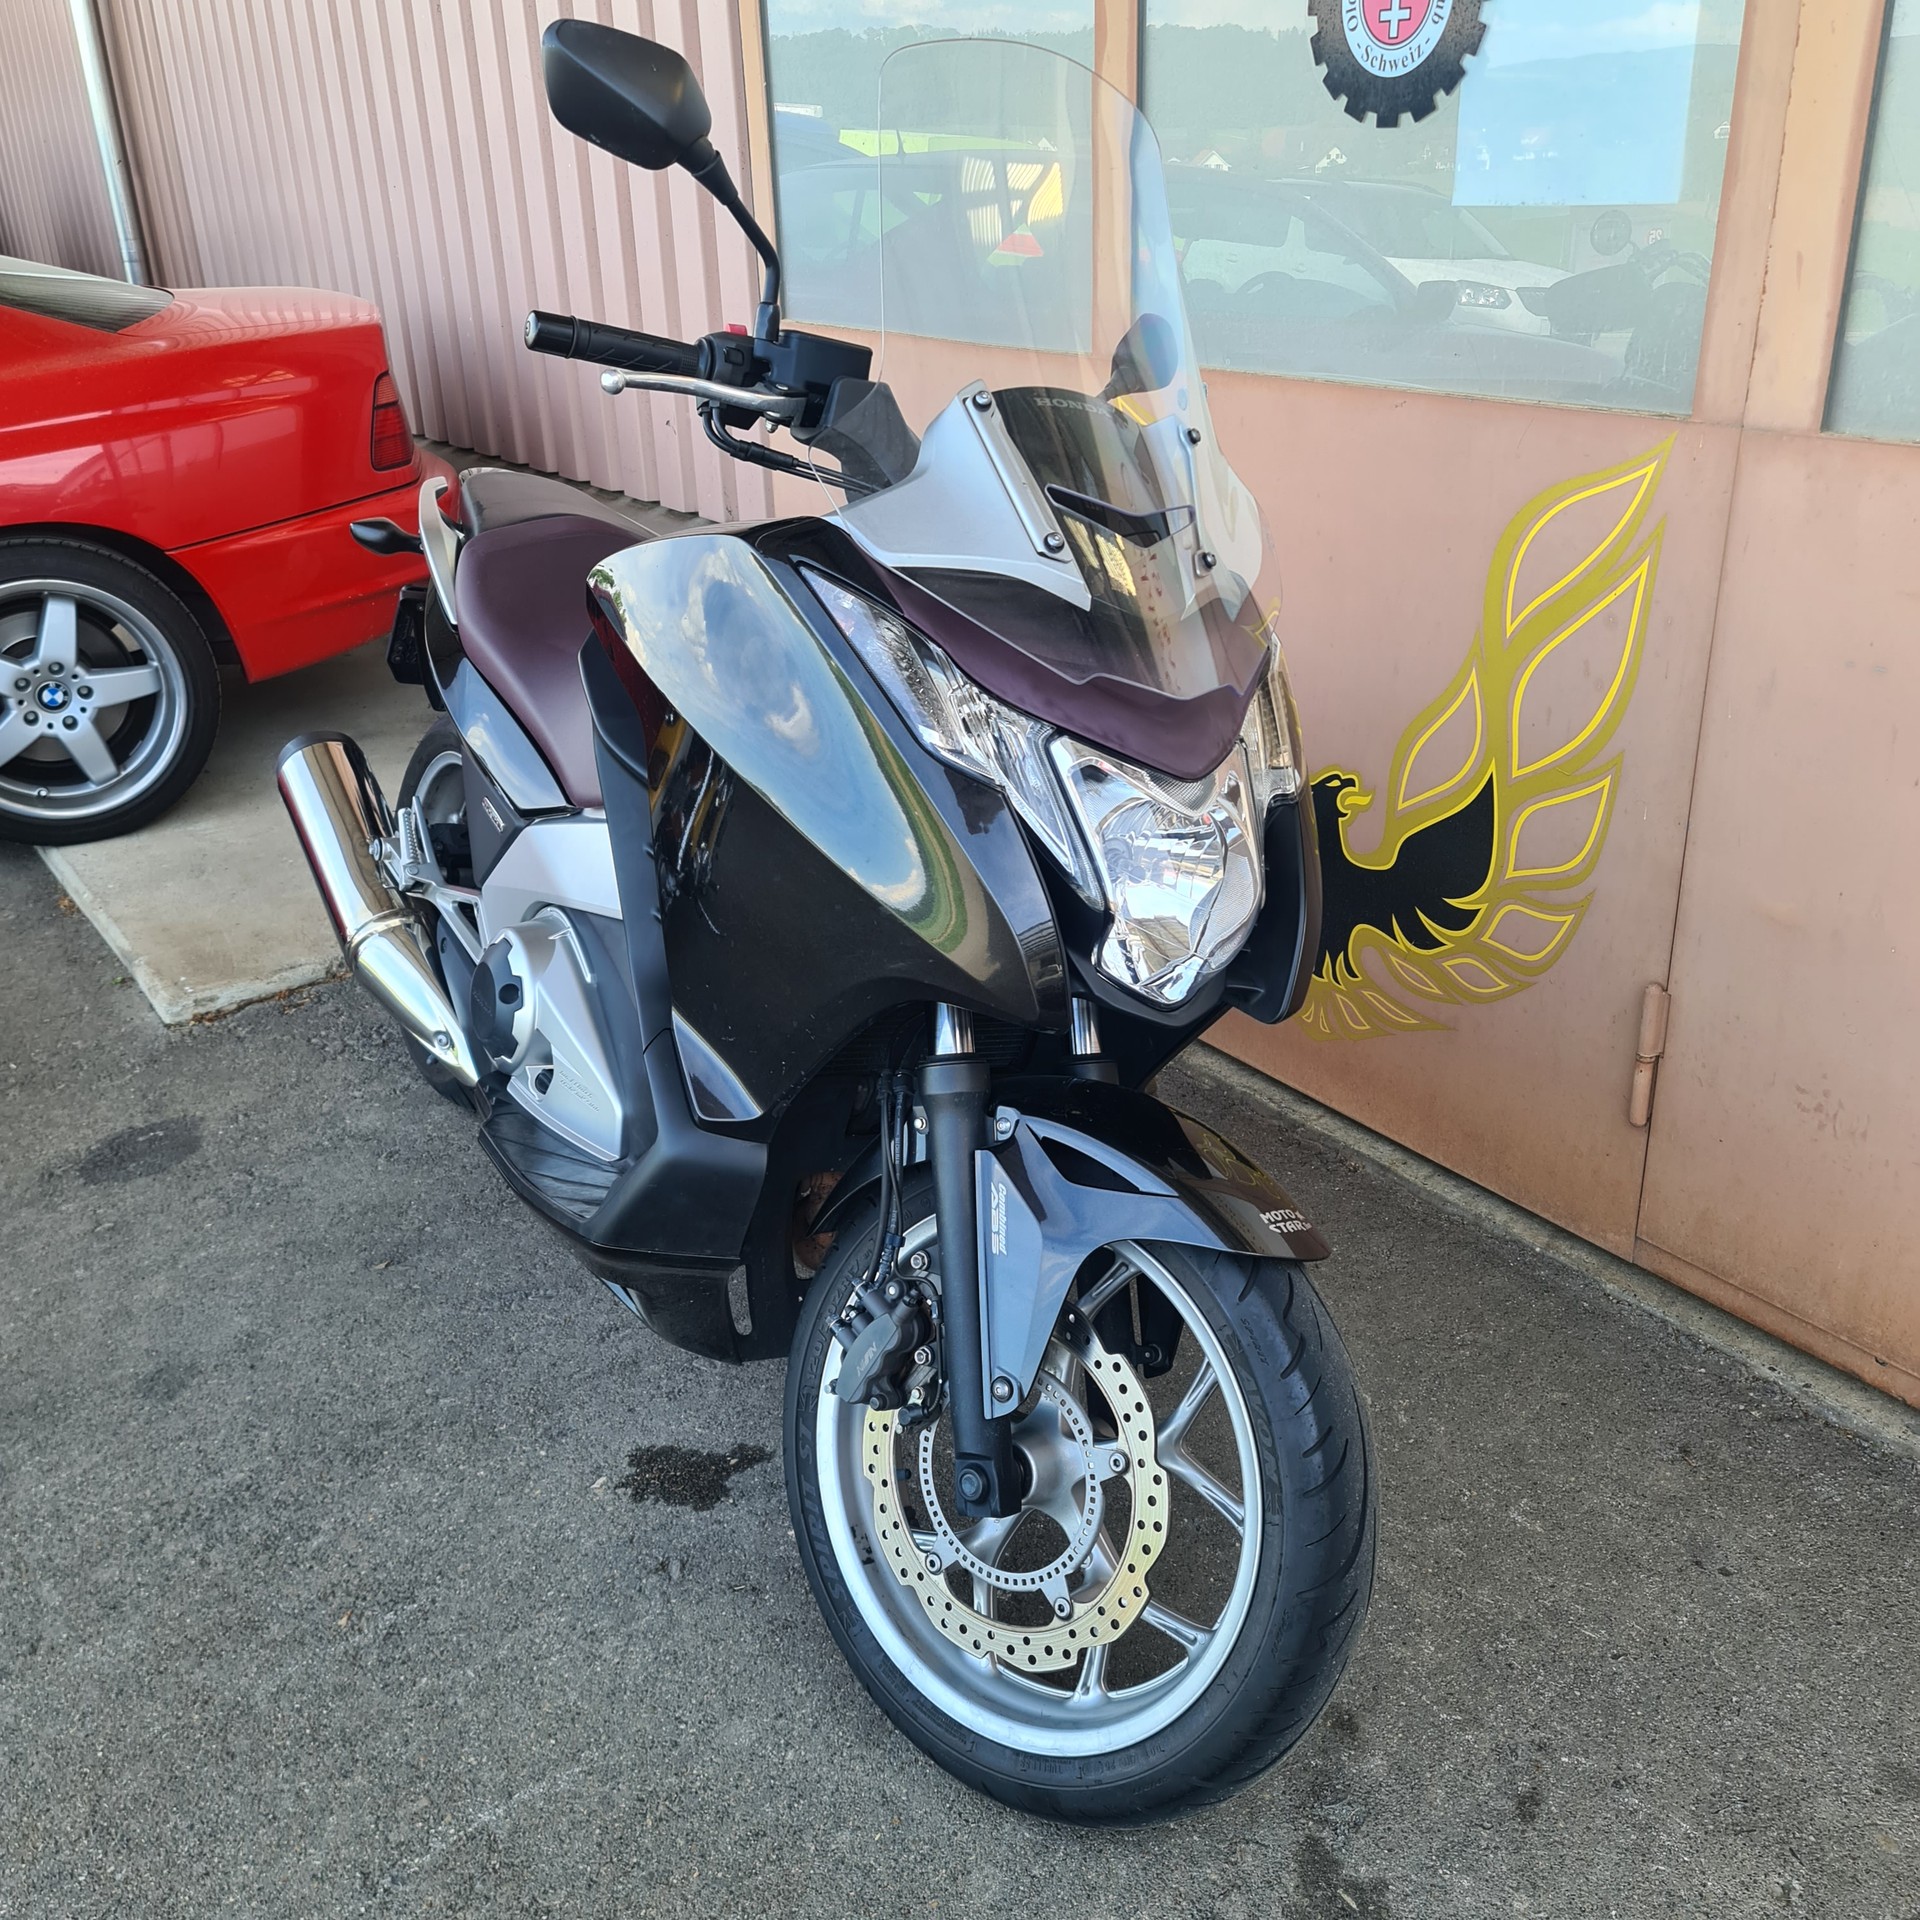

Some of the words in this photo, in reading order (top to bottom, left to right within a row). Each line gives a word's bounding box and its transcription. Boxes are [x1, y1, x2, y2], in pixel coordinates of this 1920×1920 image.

[1033, 397, 1112, 418] HONDA
[990, 1182, 999, 1256] ABS
[998, 1182, 1007, 1256] Combined
[1259, 1209, 1297, 1225] MOTO
[798, 1417, 815, 1466] ST
[801, 1475, 848, 1602] SPIRIT
